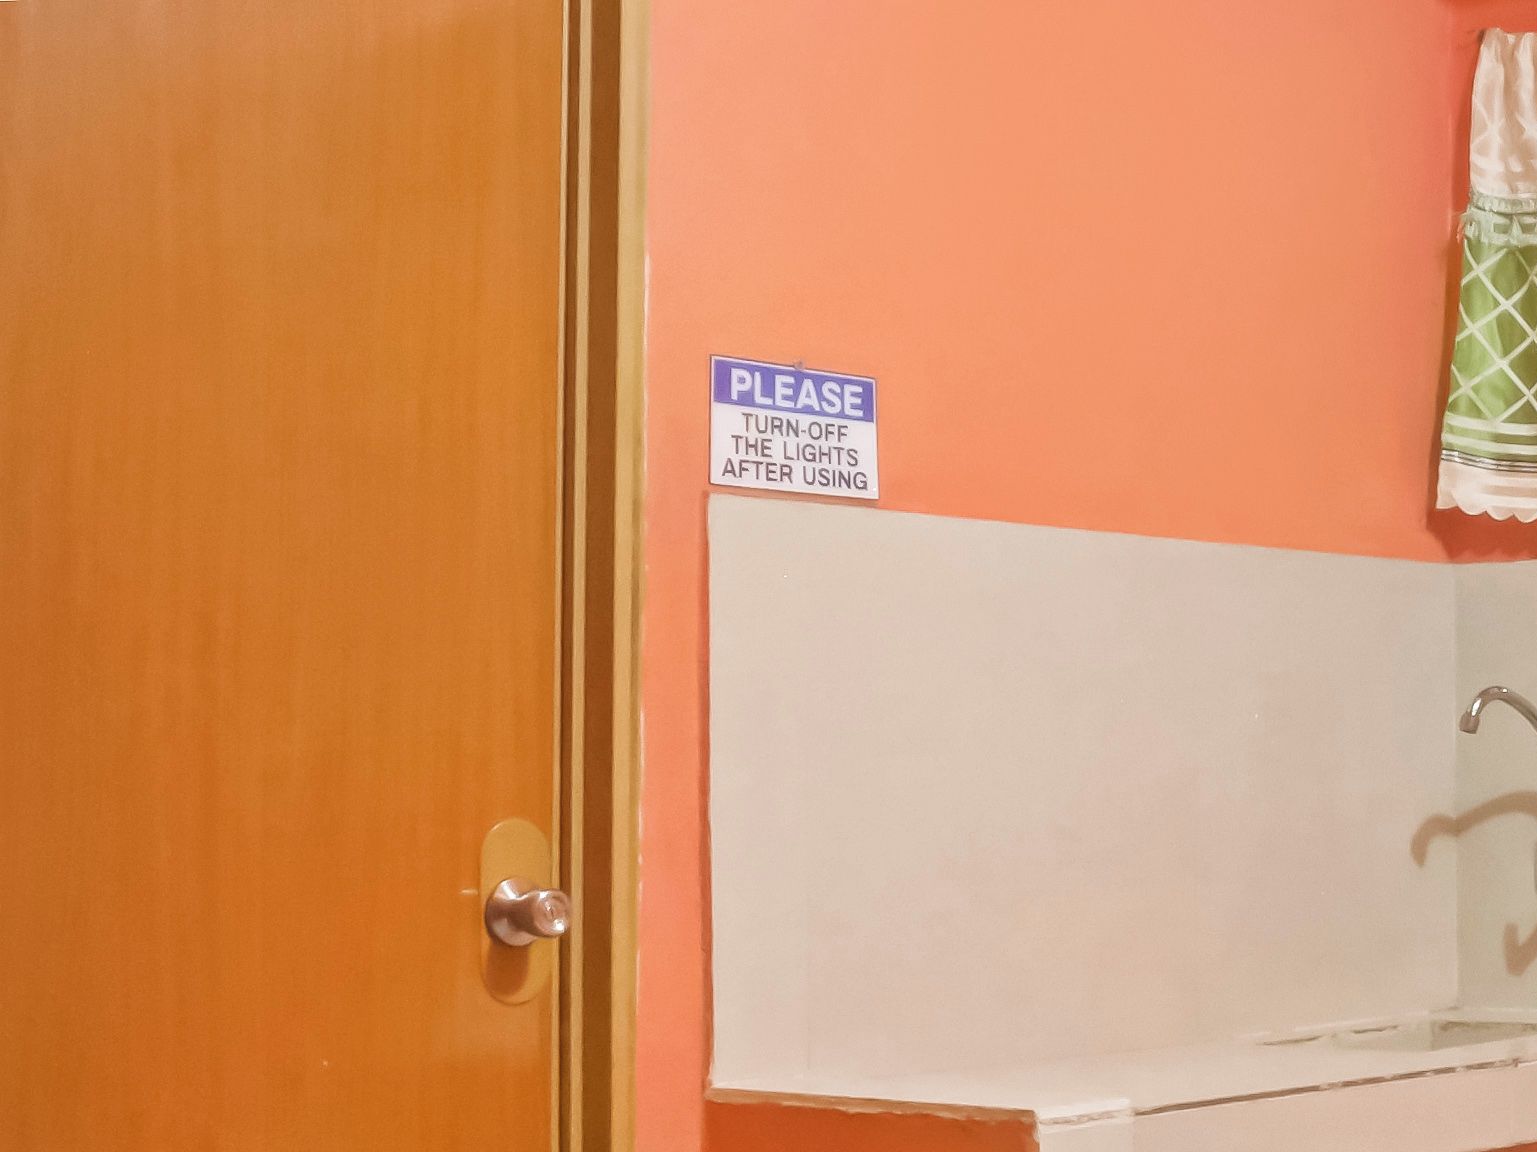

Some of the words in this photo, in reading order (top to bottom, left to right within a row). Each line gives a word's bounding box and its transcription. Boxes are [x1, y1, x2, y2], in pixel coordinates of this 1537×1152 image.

[730, 367, 864, 417] PLEASE
[741, 412, 849, 443] TURN-OFF
[731, 434, 773, 458] THE
[783, 440, 859, 467] LIGHTS
[721, 457, 793, 484] AFTER
[803, 465, 868, 491] USING
